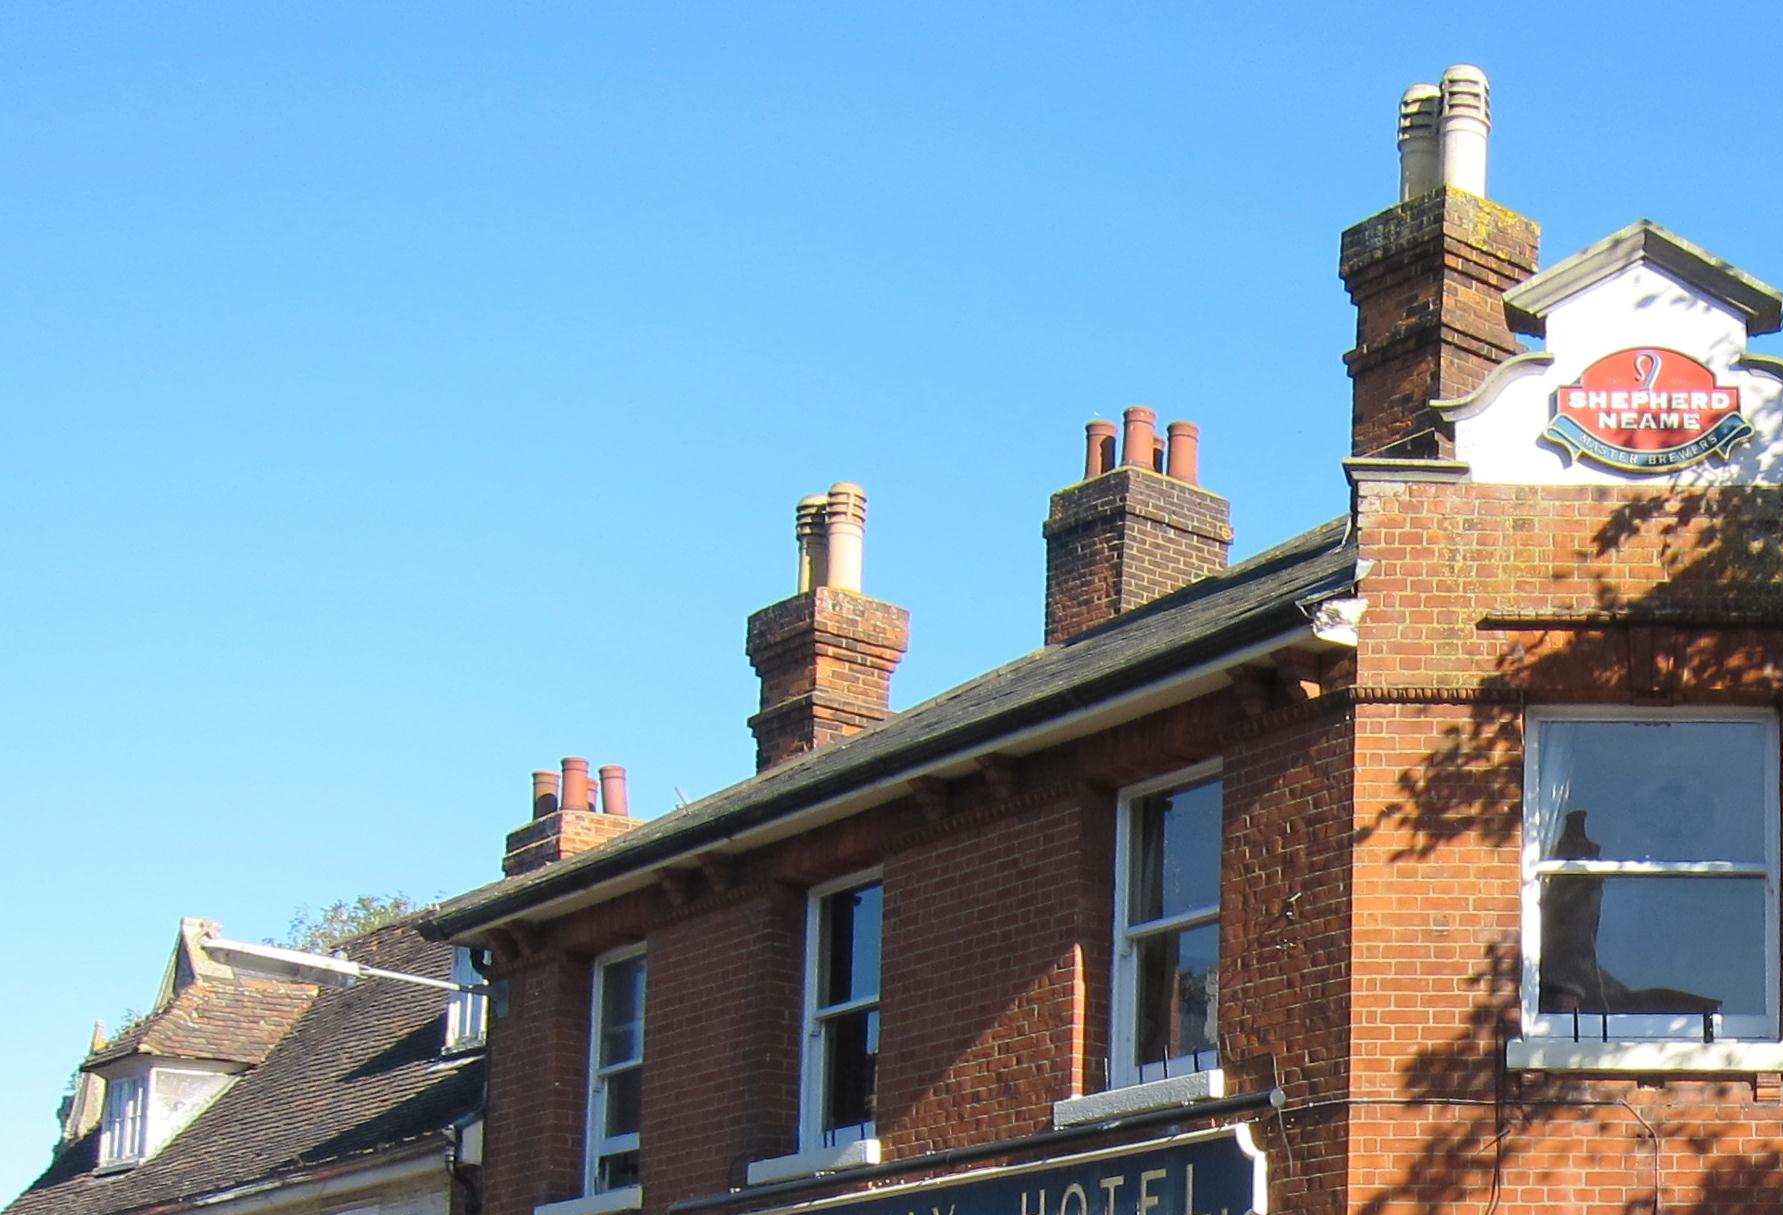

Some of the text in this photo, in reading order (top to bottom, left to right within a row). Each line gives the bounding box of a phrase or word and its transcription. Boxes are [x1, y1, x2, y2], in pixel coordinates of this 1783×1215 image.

[1568, 391, 1731, 410] SHEPHERD
[1598, 413, 1701, 430] NEAME
[1579, 433, 1718, 465] MASTER BREWERS
